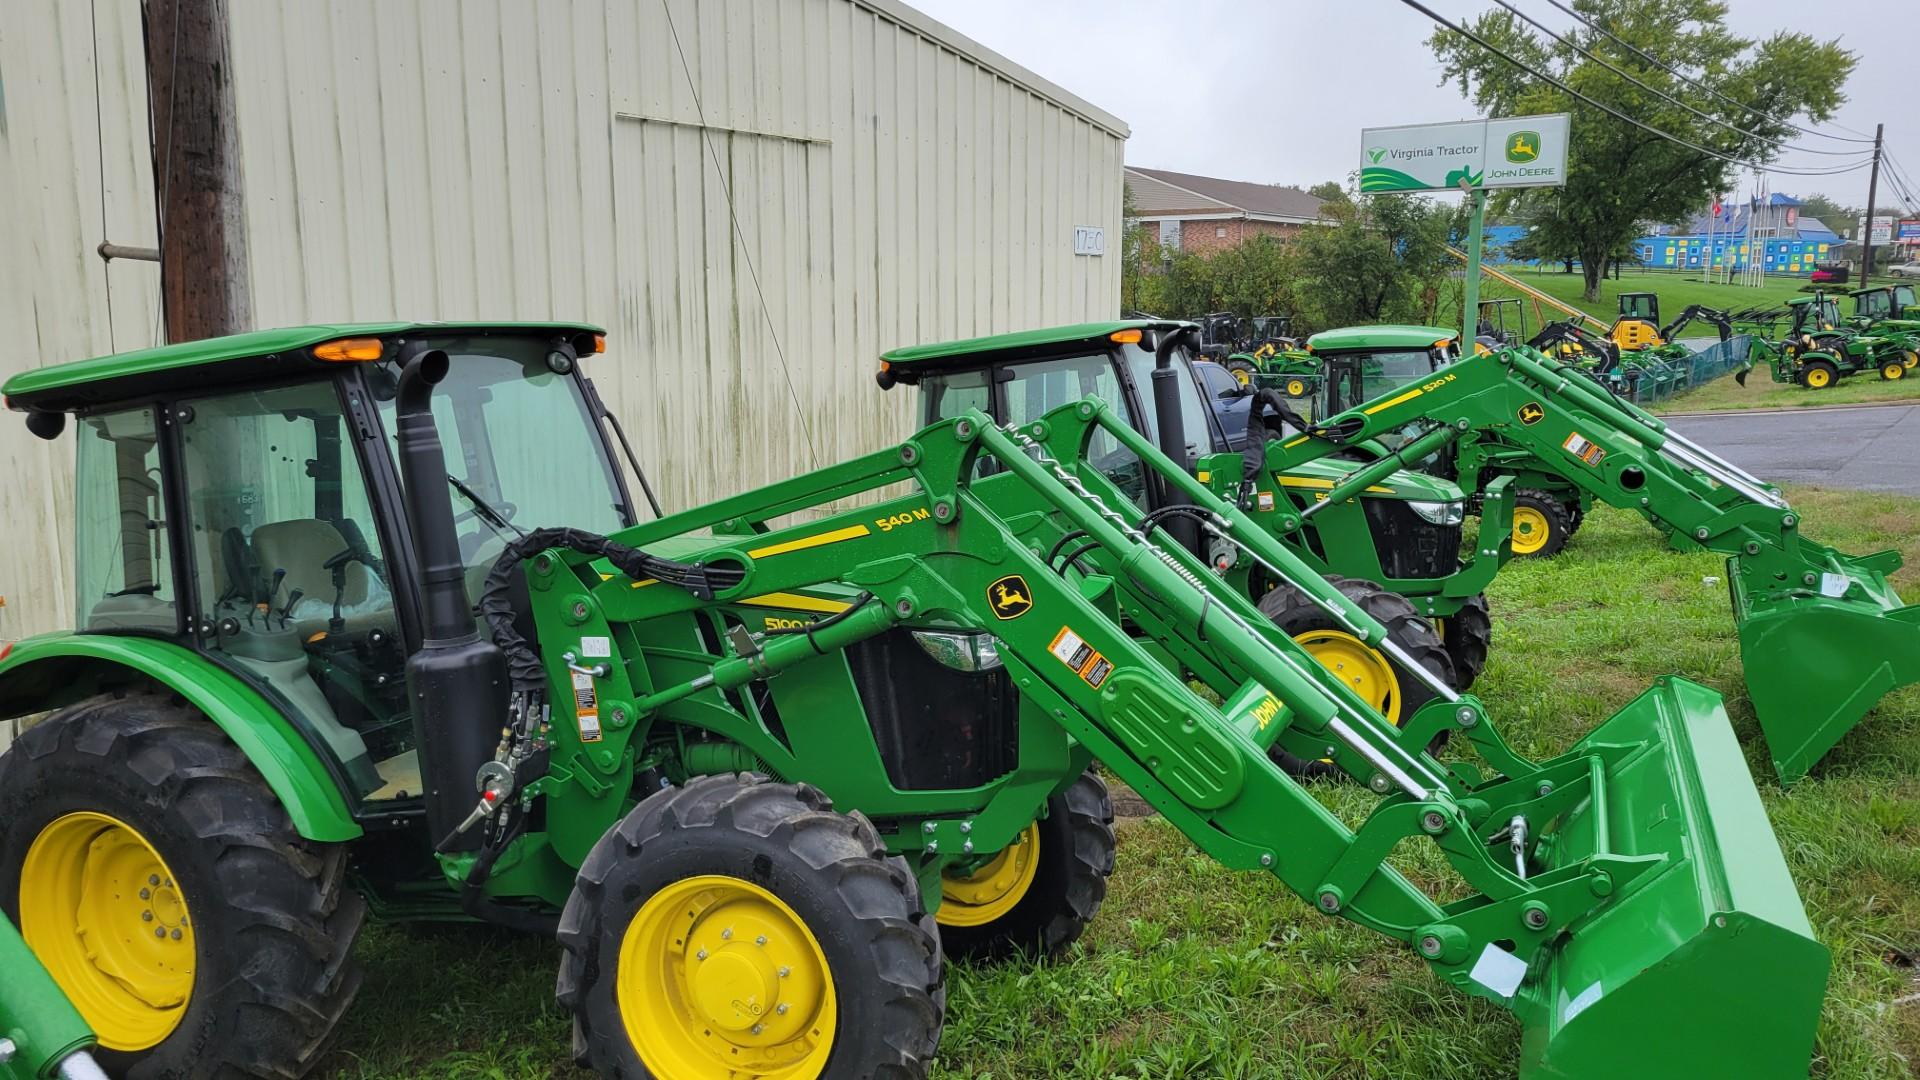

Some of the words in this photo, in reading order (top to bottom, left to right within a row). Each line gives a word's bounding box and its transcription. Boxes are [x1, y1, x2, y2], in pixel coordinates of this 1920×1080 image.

[1390, 146, 1433, 161] Virginia
[1436, 145, 1479, 157] Tractor
[1488, 169, 1517, 179] JOHN
[1519, 167, 1555, 177] DEERE
[1422, 379, 1445, 391] 520
[1444, 373, 1457, 382] M
[875, 513, 912, 531] 540
[913, 508, 931, 520] M
